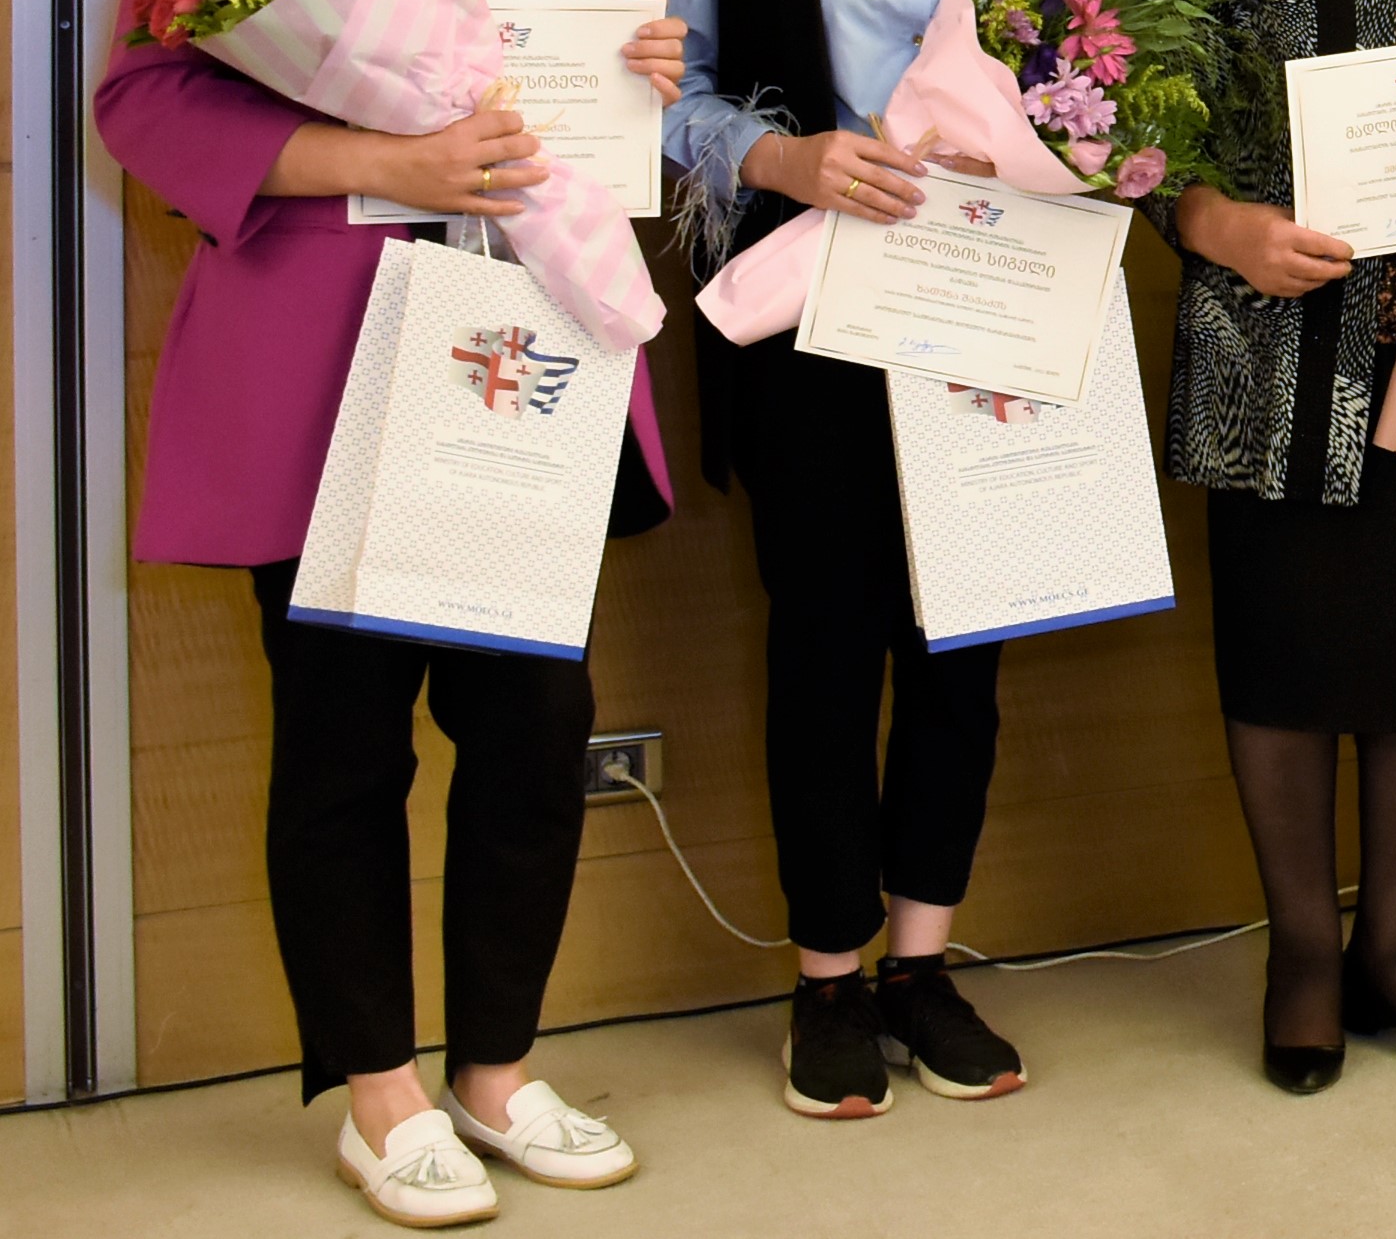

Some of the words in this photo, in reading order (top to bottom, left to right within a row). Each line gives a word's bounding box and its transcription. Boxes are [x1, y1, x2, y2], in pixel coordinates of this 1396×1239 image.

[526, 75, 599, 89] სიგელი
[884, 230, 981, 263] მადლობის
[987, 252, 1057, 278] სიგელი
